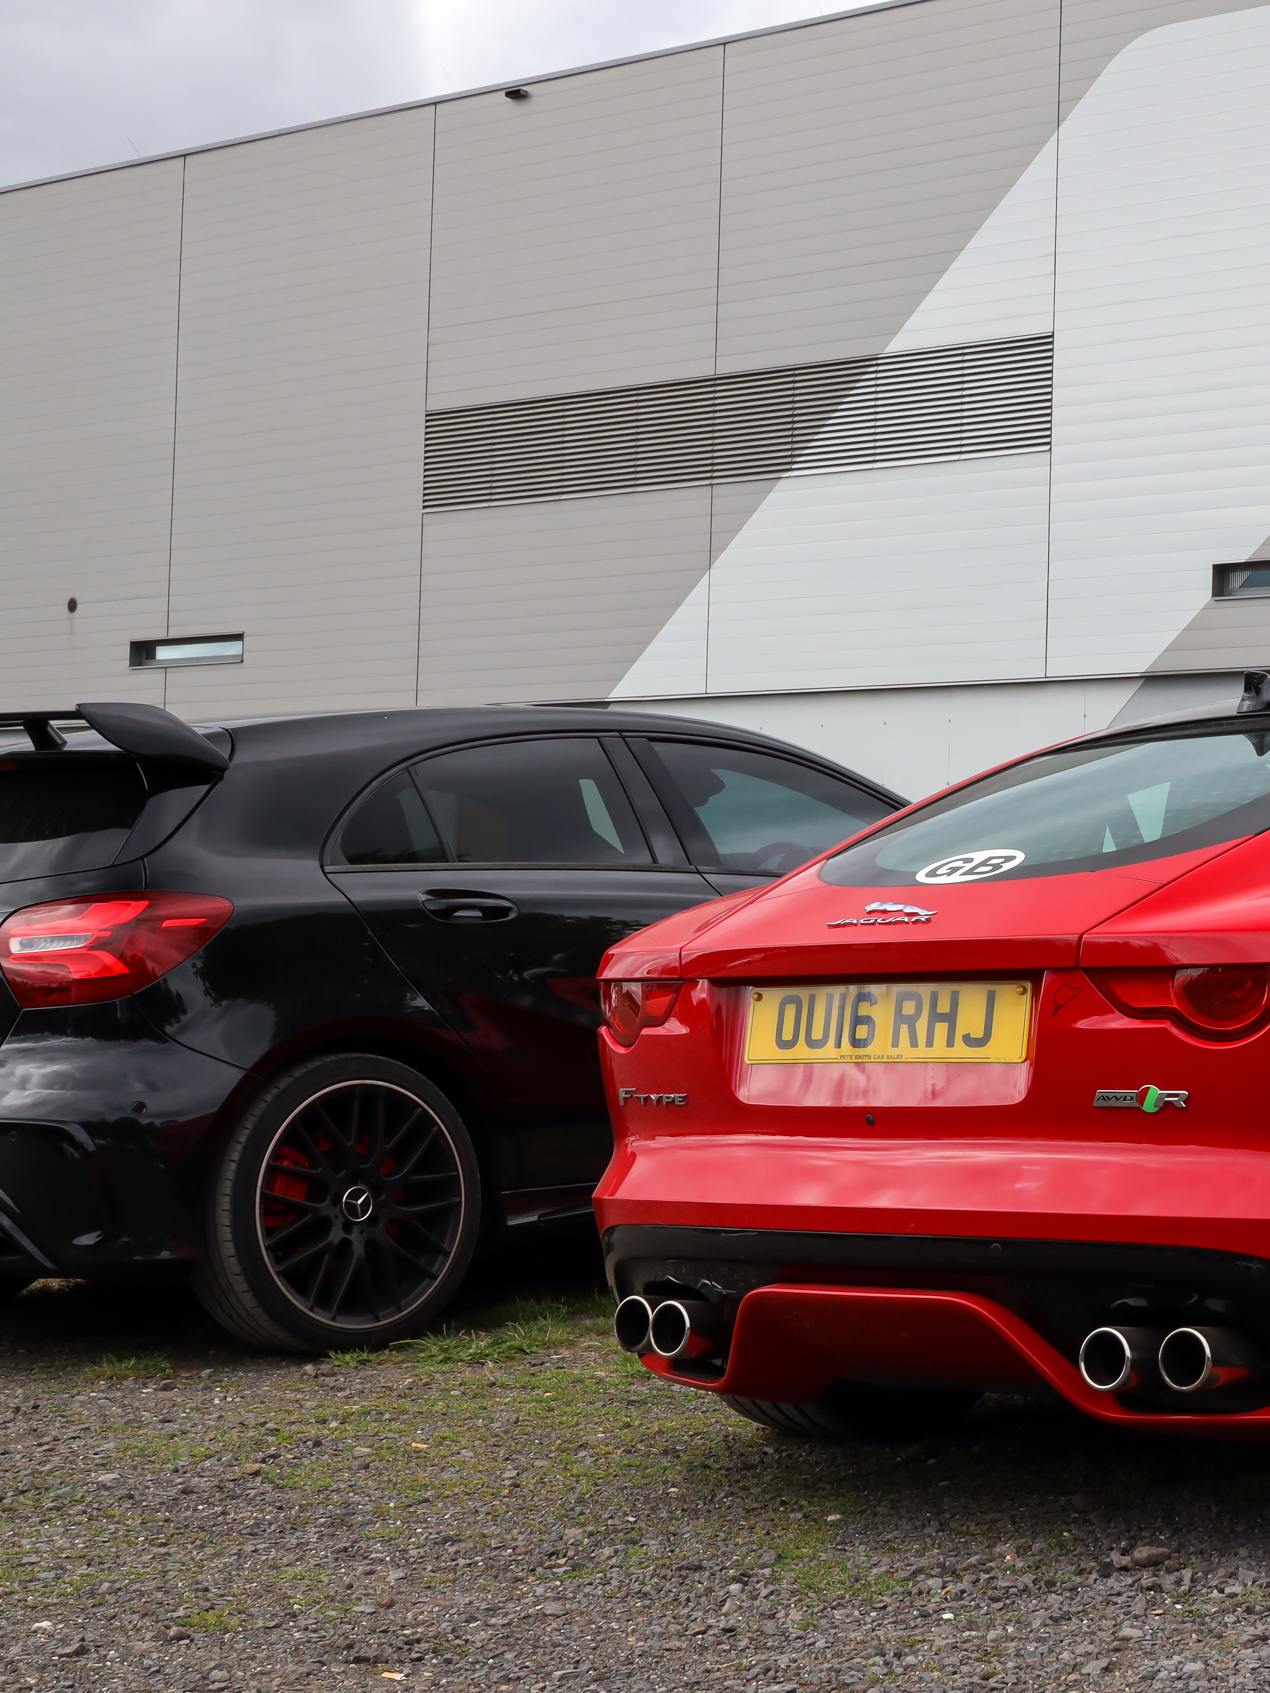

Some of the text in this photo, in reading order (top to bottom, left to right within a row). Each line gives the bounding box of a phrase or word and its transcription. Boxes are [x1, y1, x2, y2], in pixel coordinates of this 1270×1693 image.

[924, 855, 1017, 879] GB
[826, 915, 932, 929] JAGUAR
[775, 989, 997, 1050] OU16 RHJ
[1153, 1090, 1190, 1108] R
